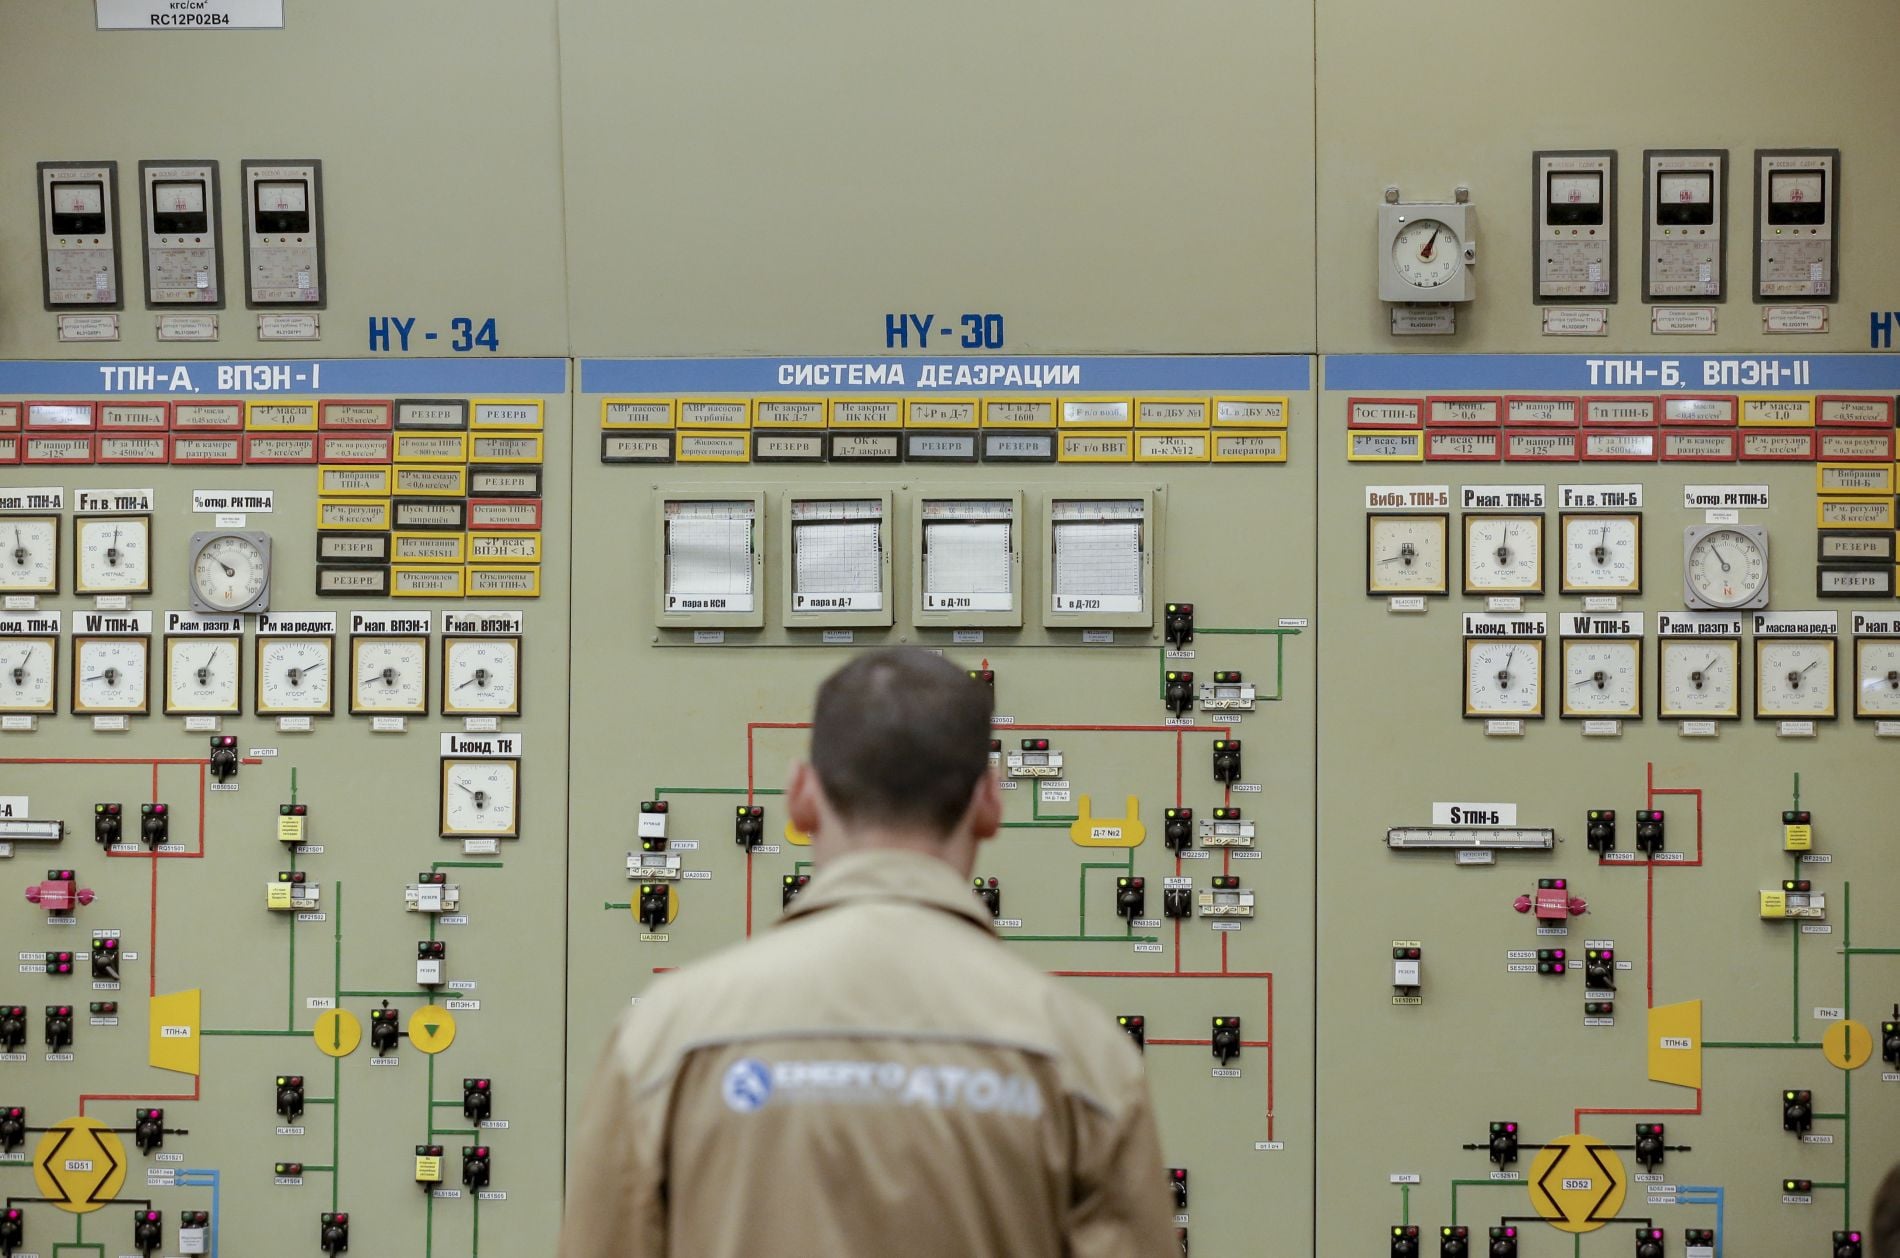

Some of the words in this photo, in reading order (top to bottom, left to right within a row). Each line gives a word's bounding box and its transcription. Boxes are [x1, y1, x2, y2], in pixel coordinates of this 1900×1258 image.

[151, 13, 230, 25] RC12P02B4
[451, 317, 500, 351] 34
[961, 314, 1004, 349] 30
[778, 363, 904, 386] СИСТЕМА
[917, 363, 1080, 388] ДЕАЭРАЦИИ
[767, 403, 781, 411] Не
[784, 405, 815, 413] закрыт
[842, 403, 856, 411] Не
[858, 405, 891, 413] закрыт
[1383, 408, 1417, 418] ТПН-Б
[411, 410, 451, 419] РЕЗЕРВ
[487, 410, 527, 419] РЕЗЕРВ
[628, 413, 650, 422] ТПН
[774, 413, 789, 421] ПК
[792, 413, 808, 423] Д-7
[846, 413, 861, 421] ПК
[863, 413, 887, 421] КСН
[949, 410, 970, 421] Д-7
[618, 442, 658, 450] РЕЗЕРВ
[769, 442, 809, 450] РЕЗЕРВ
[840, 446, 857, 455] Д-7
[859, 447, 892, 456] закрыт
[921, 442, 962, 450] РЕЗЕРВ
[998, 442, 1039, 450] РЕЗЕРВ
[339, 471, 380, 481] Вибрация
[341, 480, 370, 489] ТПН-А
[485, 478, 525, 487] РЕЗЕРВ
[1840, 480, 1871, 489] ТПН-Б
[27, 495, 61, 508] ТПН-А
[114, 496, 149, 509] ТПН-А
[204, 498, 229, 508] откр.
[243, 497, 272, 508] ТПН-А
[1370, 492, 1407, 508] Вибр.
[1409, 492, 1448, 506] ТПН-Б
[1506, 493, 1543, 506] ТПН-Б
[1601, 491, 1638, 506] ТПН-Б
[1696, 495, 1723, 506] откр.
[1739, 493, 1768, 505] ТПН-Б
[334, 543, 374, 552] РЕЗЕРВ
[1834, 542, 1877, 552] РЕЗЕРВ
[333, 575, 374, 585] РЕЗЕРВ
[1833, 577, 1875, 587] РЕЗЕРВ
[682, 600, 703, 609] пара
[710, 599, 726, 608] КСН
[810, 599, 830, 609] пара
[838, 598, 852, 608] Д-7
[947, 598, 971, 608] Д-7(1)
[1076, 600, 1100, 610] Д-7(2)
[0, 622, 24, 633] онд.
[27, 620, 58, 632] ТПН-А
[86, 615, 102, 631] W
[105, 618, 139, 632] ТПН-А
[390, 619, 429, 632] ВПЭН-1
[480, 619, 519, 632] ВПЭН-1
[1511, 621, 1545, 634] ТПН-Б
[1573, 616, 1591, 633] W
[1593, 619, 1631, 634] ТПН-Б
[1766, 623, 1796, 633] масла
[497, 739, 513, 752] ТК
[1450, 806, 1461, 824] S
[1463, 810, 1499, 824] ТПН-Б
[312, 999, 329, 1008] ПН-1
[450, 1001, 477, 1010] ВПЭН-1
[1820, 1009, 1838, 1018] ПН-2
[164, 1028, 188, 1038] ТПН-А
[1665, 1039, 1689, 1049] ТПН-Б
[68, 1161, 90, 1170] SD51
[1565, 1180, 1588, 1190] SD52
